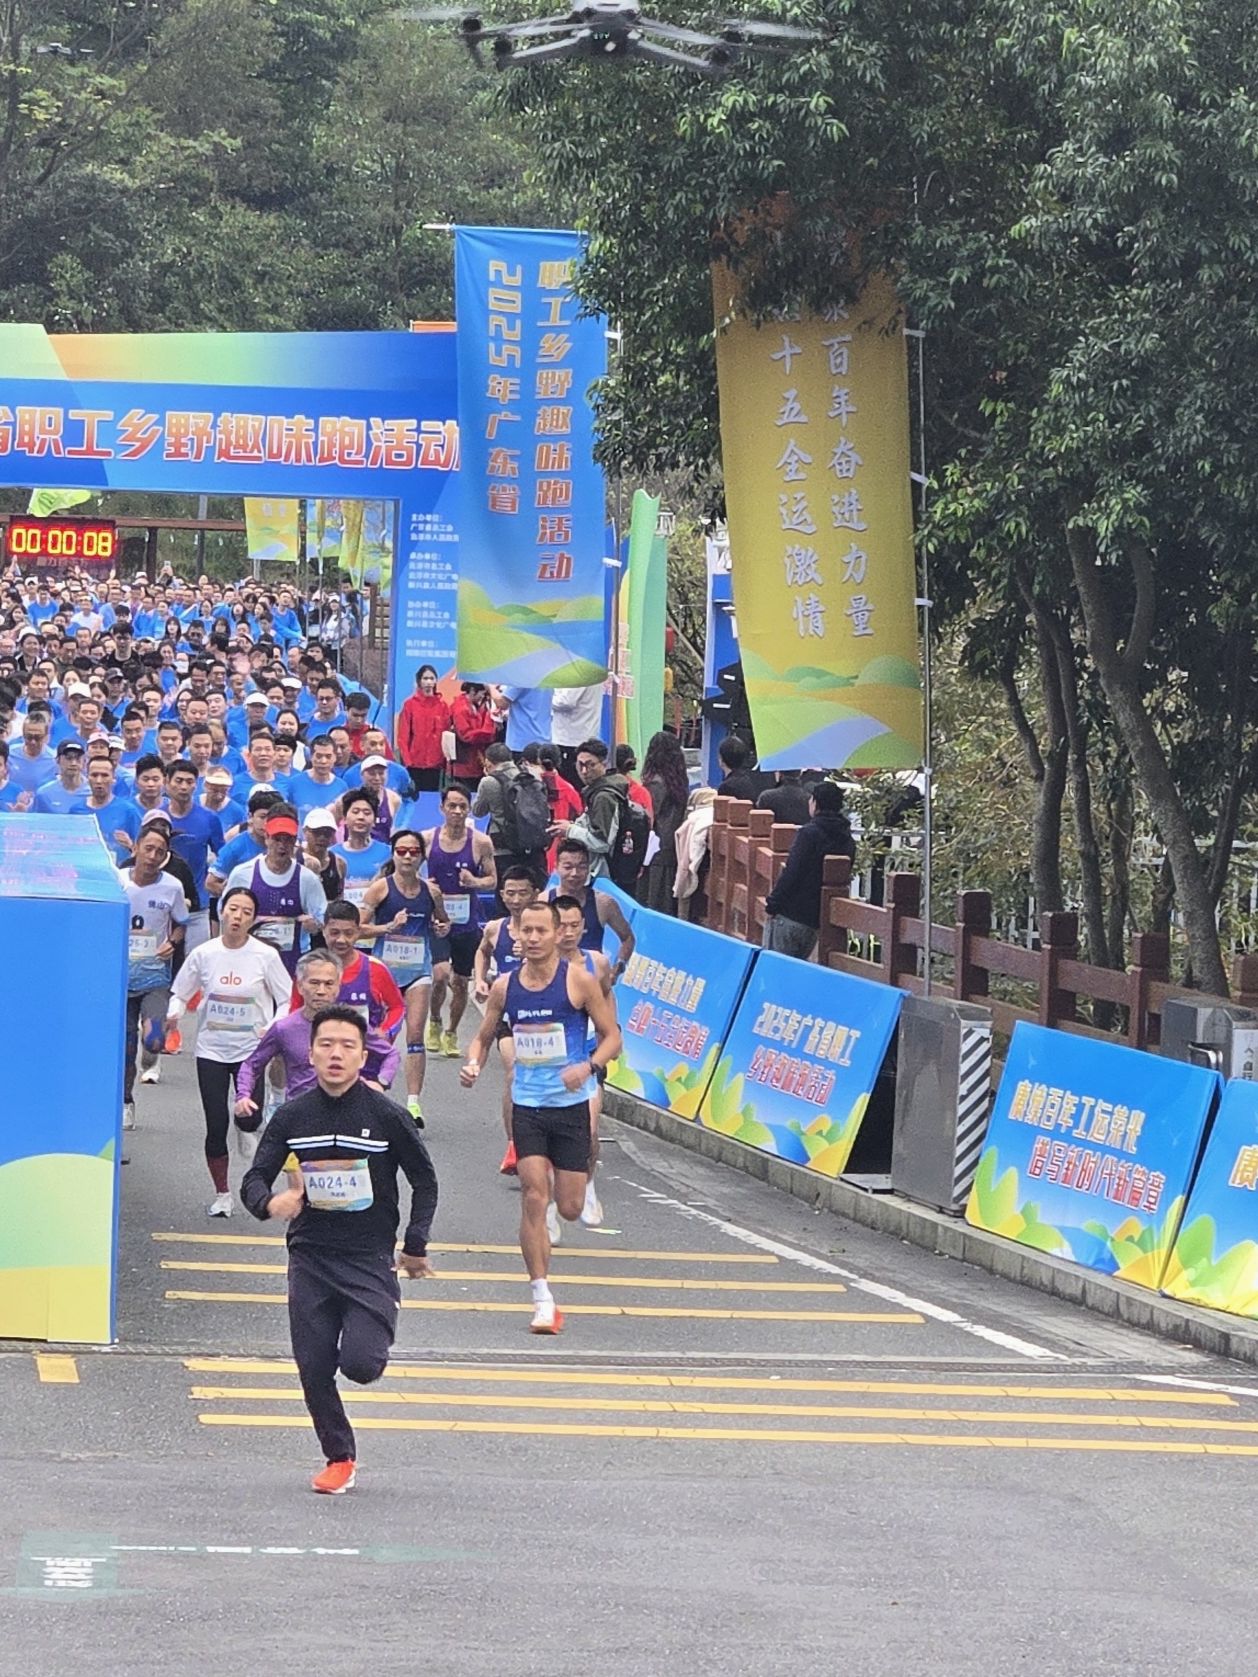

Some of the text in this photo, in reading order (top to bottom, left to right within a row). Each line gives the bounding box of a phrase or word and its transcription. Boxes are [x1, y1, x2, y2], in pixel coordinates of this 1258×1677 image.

[485, 260, 522, 514] 2025年广东省
[533, 261, 574, 583] 职工乡野趣味跑活动
[220, 971, 242, 986] alo
[516, 1036, 554, 1049] A018-4
[752, 1002, 862, 1067] 2025年广东省职工
[746, 1044, 837, 1108] 乡野趣味跑活动
[309, 1175, 357, 1190] A024-4
[1027, 1134, 1167, 1215] 谱写新时代新篇章
